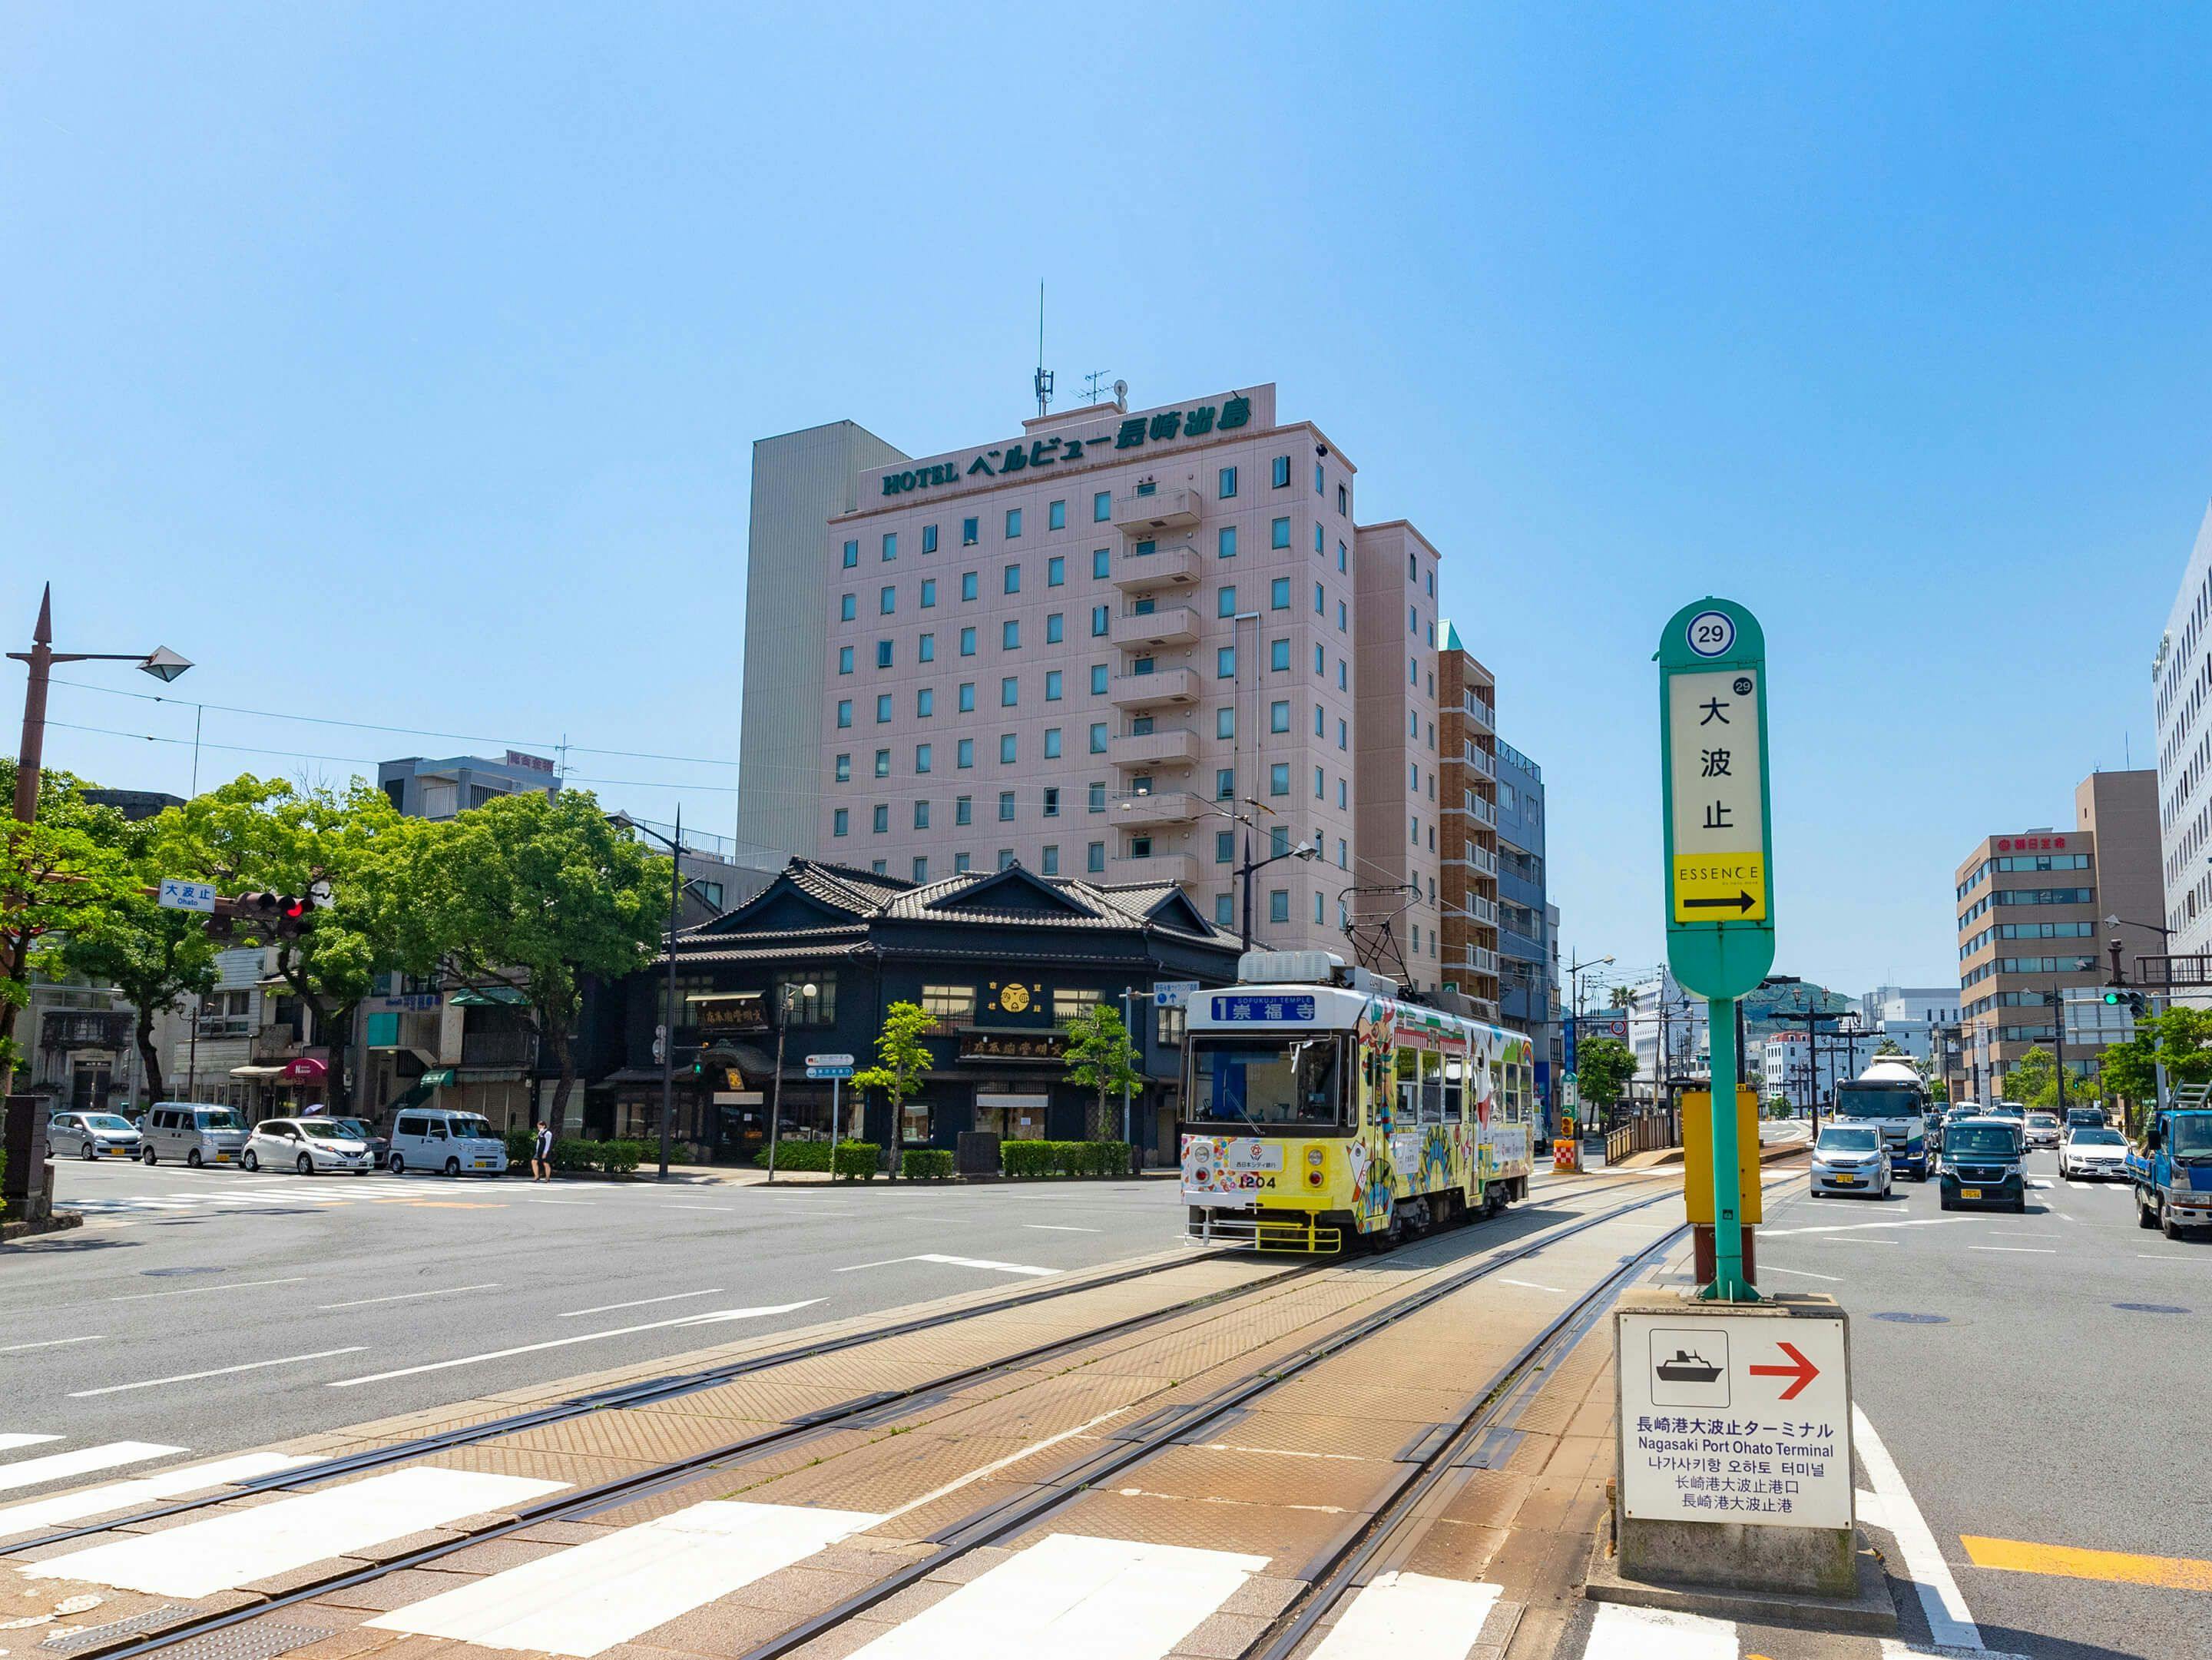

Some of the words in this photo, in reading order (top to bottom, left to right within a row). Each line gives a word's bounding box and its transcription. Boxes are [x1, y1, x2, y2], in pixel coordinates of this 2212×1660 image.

[882, 462, 959, 495] HOTEL
[966, 396, 1252, 476] ベルビュー長崎出島
[1697, 625, 1724, 643] 29
[1735, 681, 1751, 692] 29
[1699, 697, 1734, 829] 大波止
[1680, 866, 1758, 880] ESSENCE
[165, 884, 210, 900] 大波止
[177, 897, 198, 906] Ohato
[1217, 998, 1227, 1020] 1
[1233, 1003, 1315, 1020] 崇福寺
[1240, 1176, 1276, 1189] 1204
[1637, 1416, 1834, 1440] 長崎港大波止ターミナル
[1638, 1436, 1699, 1453] Nagasaki
[1702, 1440, 1730, 1453] Port
[1733, 1440, 1773, 1456] Ohato
[1776, 1442, 1834, 1458] Terminal
[1648, 1456, 1721, 1473] 나가사키항
[1727, 1459, 1772, 1475] 오하토
[1781, 1461, 1825, 1478] 터미널
[1674, 1475, 1800, 1495] 长崎港大波止港口
[1681, 1493, 1793, 1513] 長崎港大波止港
